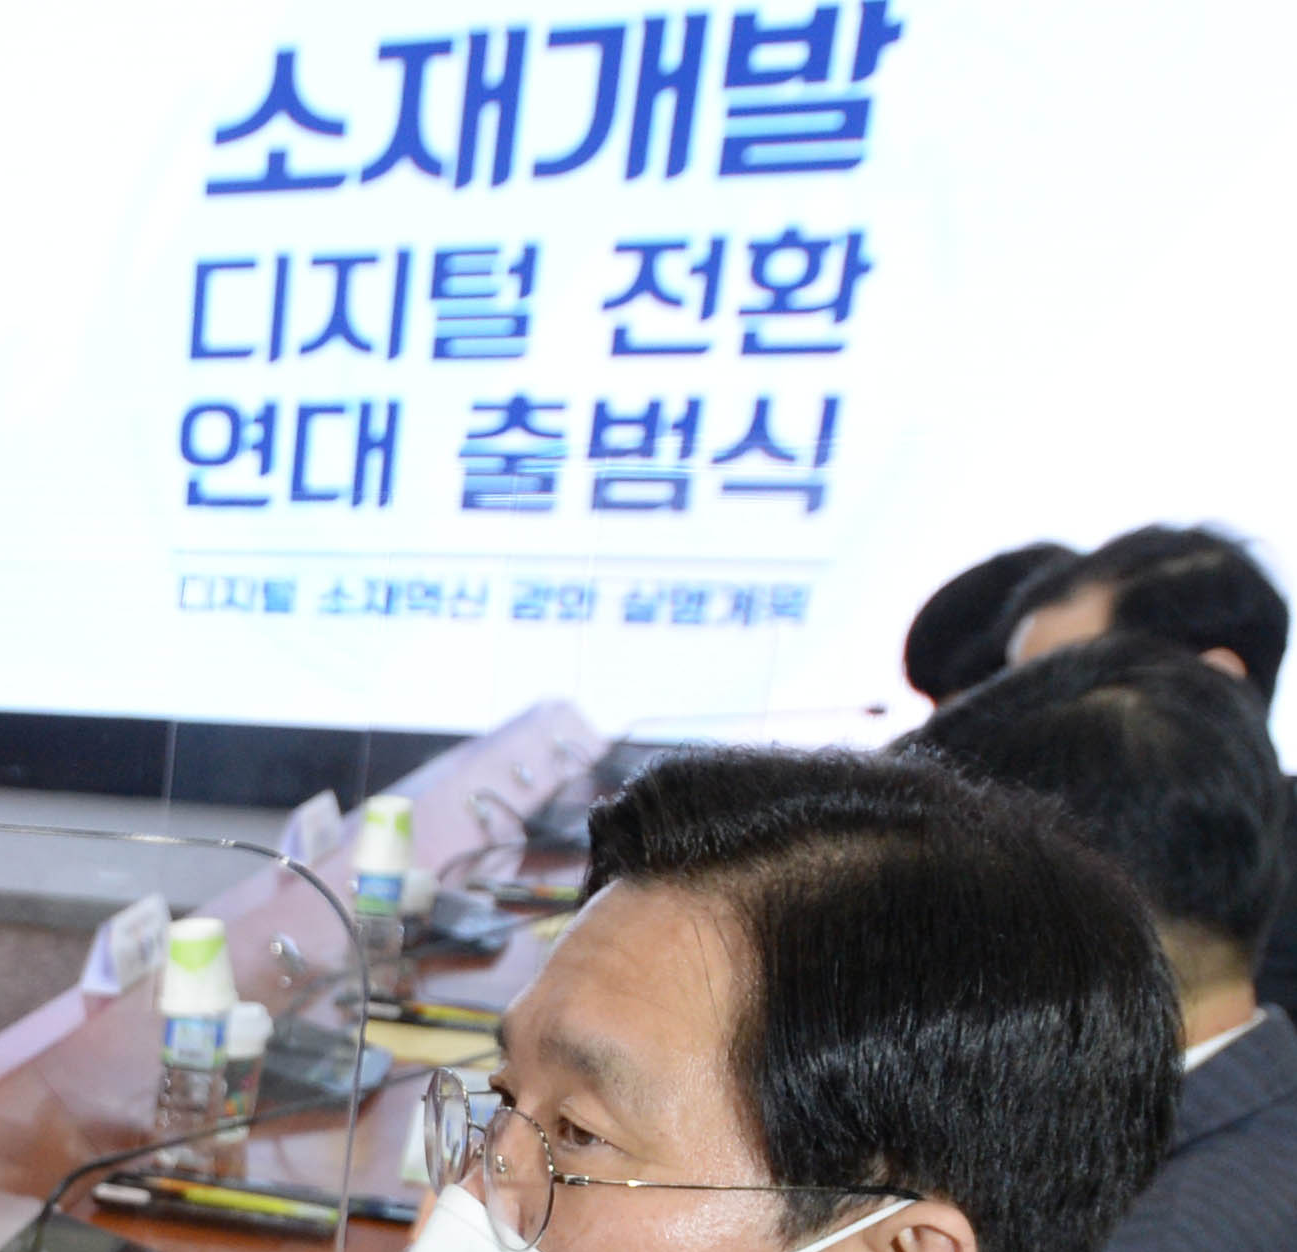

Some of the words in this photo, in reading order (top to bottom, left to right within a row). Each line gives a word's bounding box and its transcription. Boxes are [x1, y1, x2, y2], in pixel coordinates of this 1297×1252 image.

[205, 0, 905, 196] 소재개발
[190, 242, 541, 363] 디지털
[602, 225, 873, 357] 전환
[179, 398, 402, 509] 연대
[459, 393, 842, 513] 출범식
